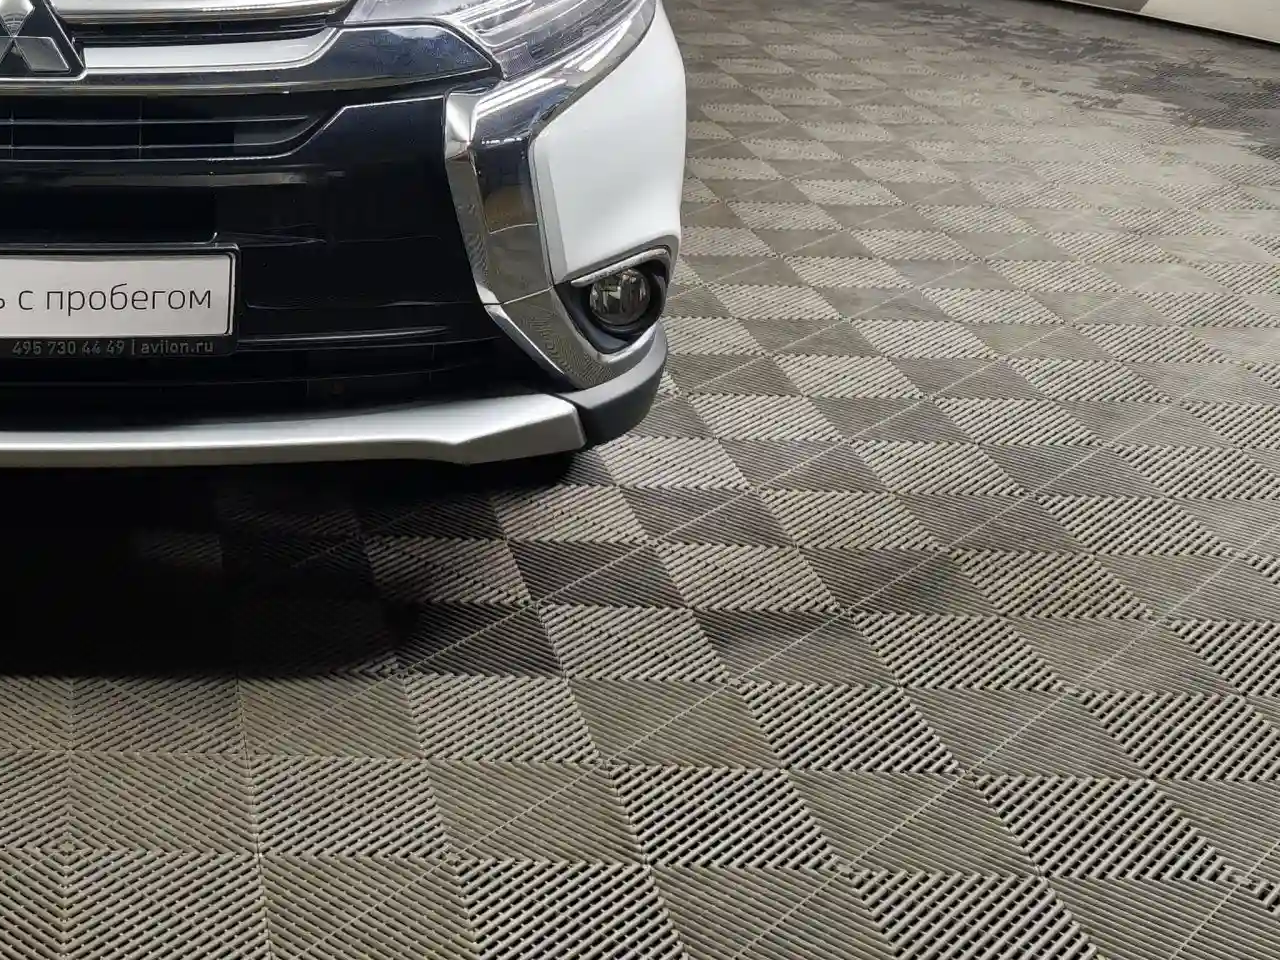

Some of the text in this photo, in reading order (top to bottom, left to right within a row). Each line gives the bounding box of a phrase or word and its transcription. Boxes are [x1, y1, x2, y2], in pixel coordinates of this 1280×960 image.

[18, 290, 34, 311] с
[46, 283, 212, 317] пробегом
[11, 341, 43, 355] 495
[47, 341, 76, 355] 730
[81, 341, 102, 355] 44
[106, 341, 125, 355] 49
[140, 339, 215, 355] avilon.ru
